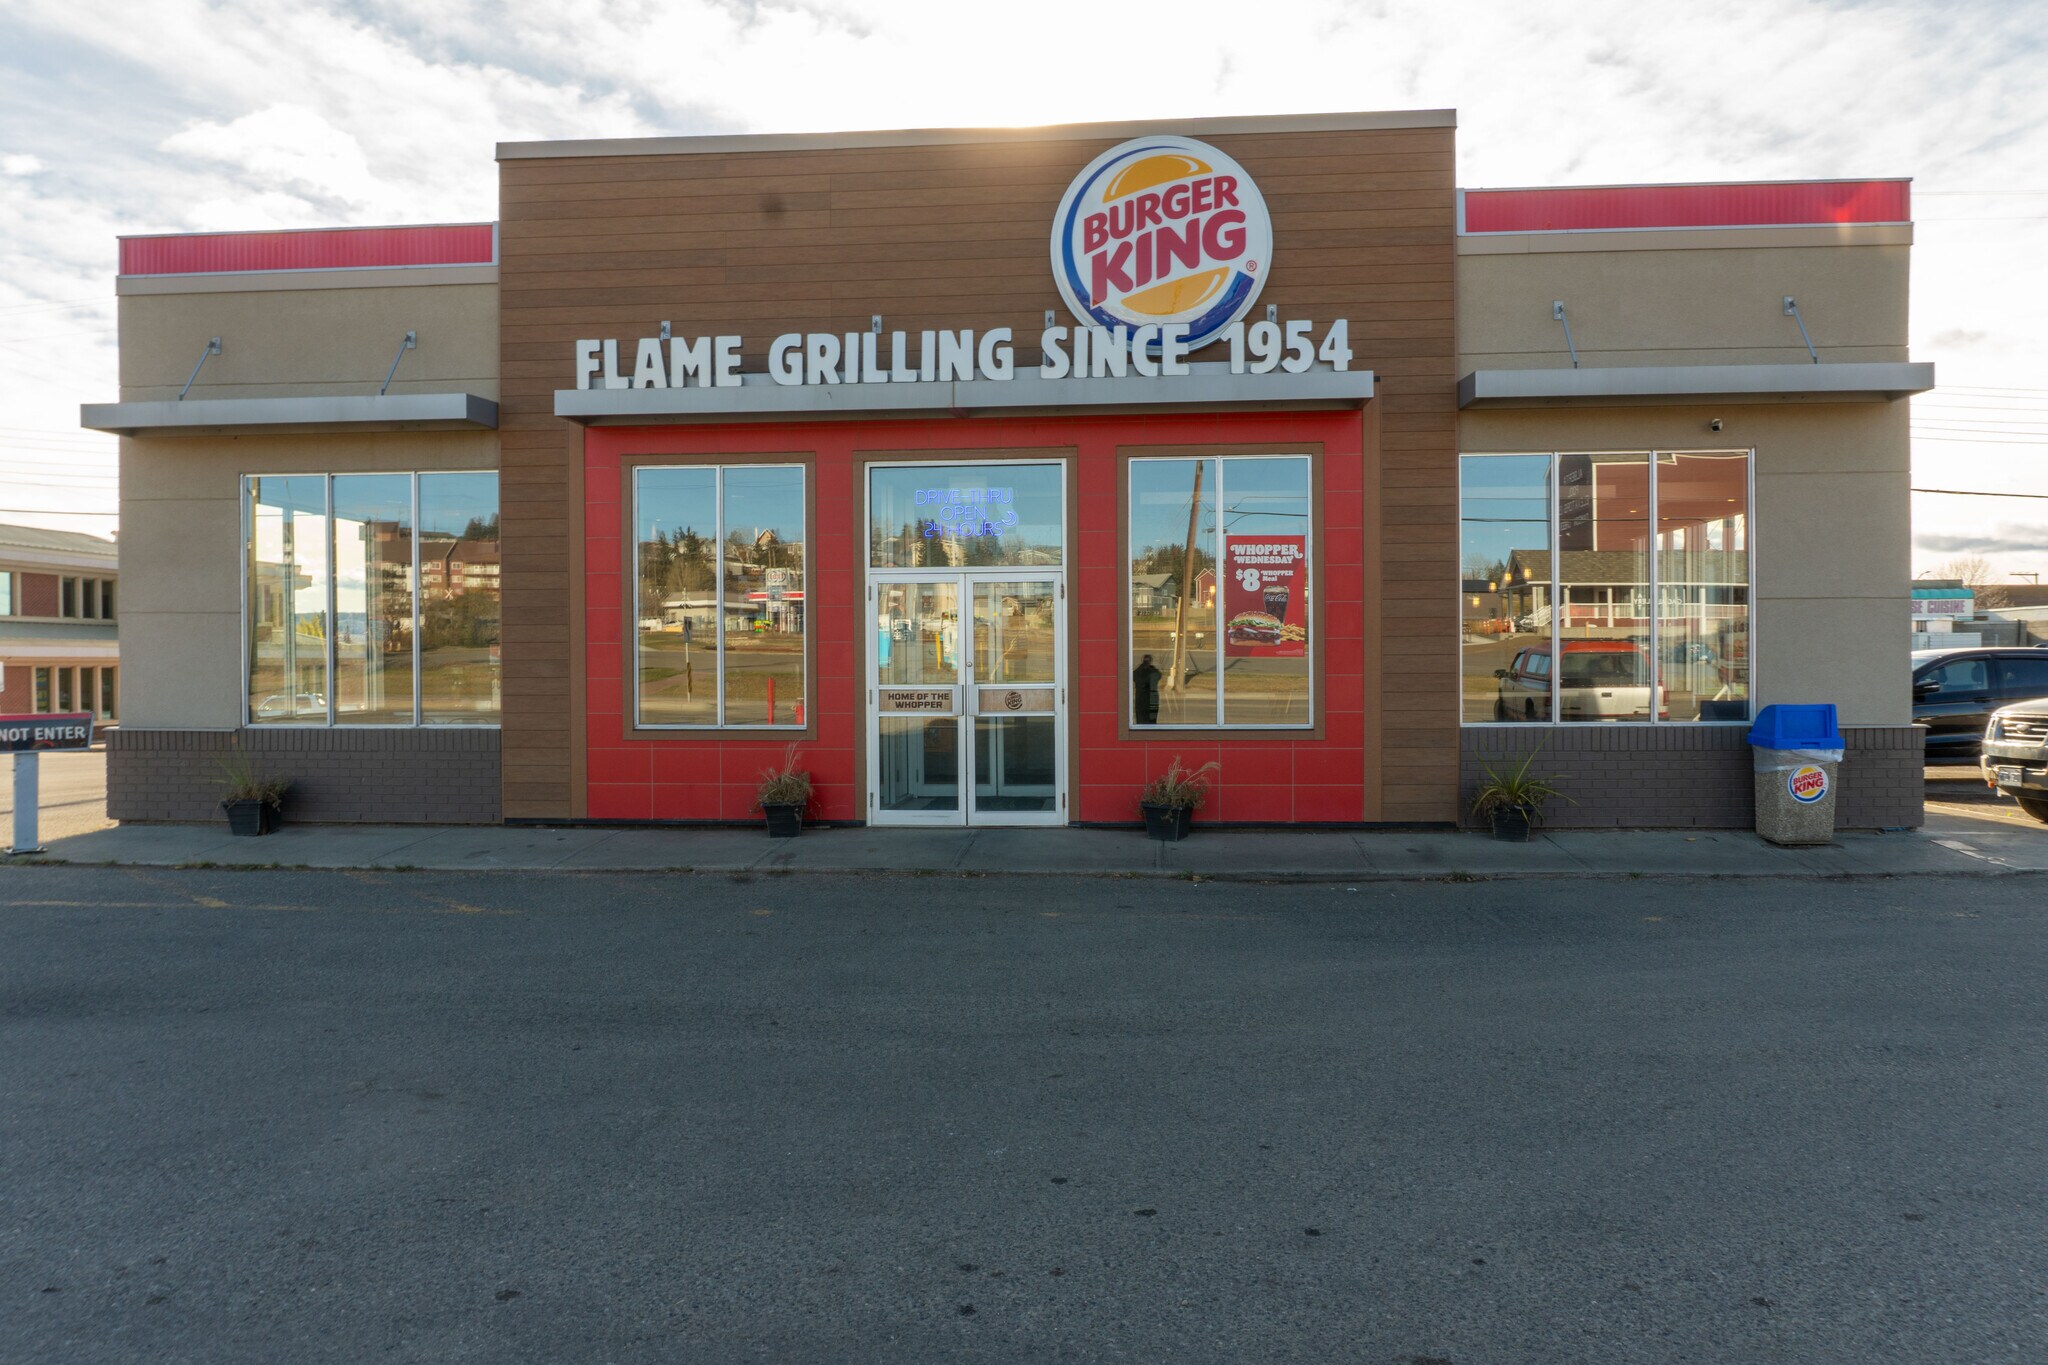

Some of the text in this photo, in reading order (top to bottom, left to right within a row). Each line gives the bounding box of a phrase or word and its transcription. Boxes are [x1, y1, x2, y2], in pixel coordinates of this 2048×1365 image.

[1084, 175, 1239, 255] BURGER
[1090, 209, 1246, 309] KING
[574, 318, 1354, 390] FLAME GRILLING SINCE 1954
[915, 489, 1013, 505] DRIVE-THRU
[940, 506, 987, 521] OPEN
[924, 522, 1004, 538] 24 HOURS
[1230, 544, 1303, 559] WHOPPER
[1233, 556, 1294, 564] WEDNESDAY
[1235, 568, 1261, 592] $8
[1927, 600, 1965, 613] CUISINE
[888, 692, 950, 701] HOME OF THE
[894, 701, 943, 709] WHOPPER
[0, 726, 86, 742] NOT ENTER
[1793, 771, 1823, 785] BURGER
[1793, 778, 1824, 794] KING
